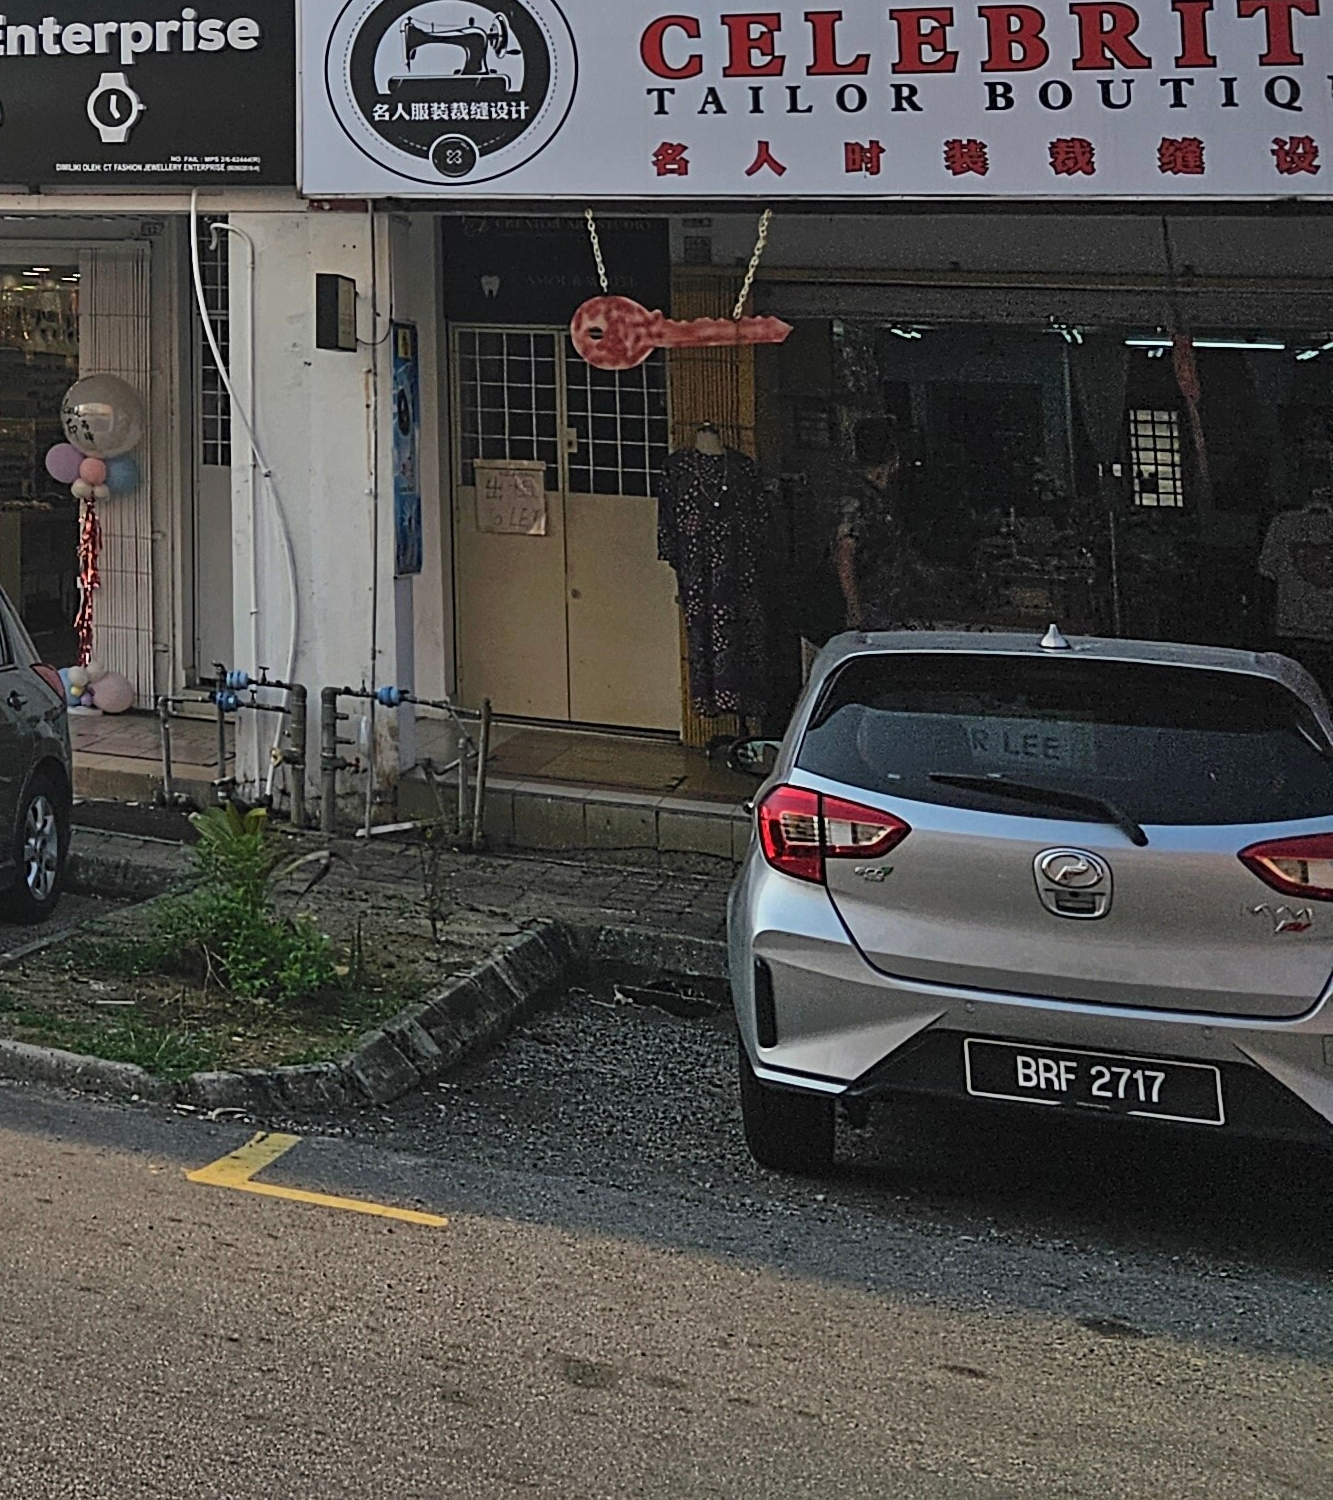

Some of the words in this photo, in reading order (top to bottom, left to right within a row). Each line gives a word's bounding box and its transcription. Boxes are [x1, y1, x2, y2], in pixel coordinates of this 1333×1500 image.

[372, 101, 530, 122] 名人服装裁缝设计
[645, 82, 924, 116] TAILOR
[984, 74, 1333, 113] BOUTIQ
[103, 163, 113, 172] CT
[113, 163, 143, 172] FASHION
[143, 163, 182, 172] JEWELLERY
[183, 163, 226, 172] ENTERPRISE
[651, 134, 1322, 178] 名人时装裁缝设
[1016, 1054, 1077, 1093] BRF
[1089, 1065, 1166, 1104] 2717
